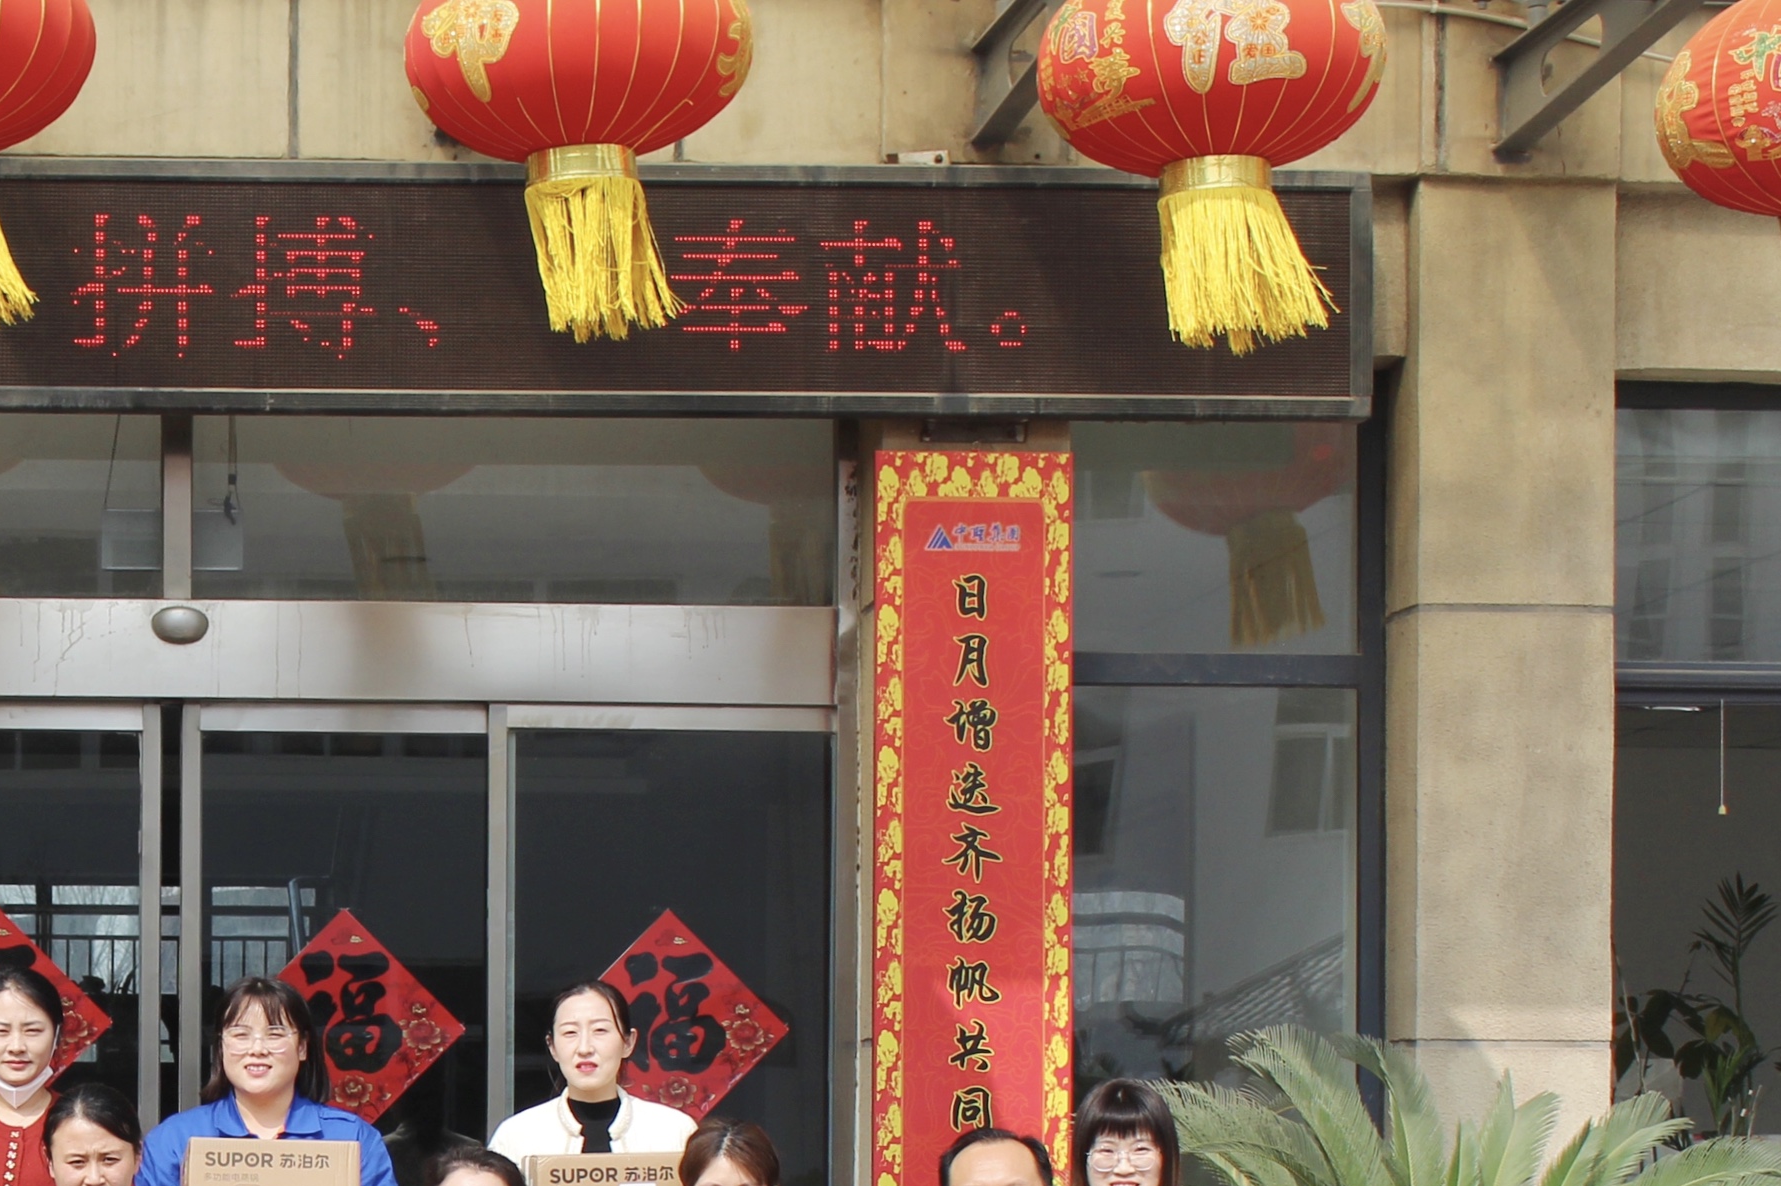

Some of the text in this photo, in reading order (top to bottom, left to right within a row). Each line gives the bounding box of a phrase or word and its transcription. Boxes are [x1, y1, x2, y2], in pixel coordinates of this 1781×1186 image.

[1191, 29, 1208, 65] 公正
[299, 950, 403, 1074] 福
[623, 951, 727, 1073] 福
[204, 1151, 330, 1169] SUPOR 苏泊尔
[549, 1165, 674, 1184] SUPOR 苏泊尔
